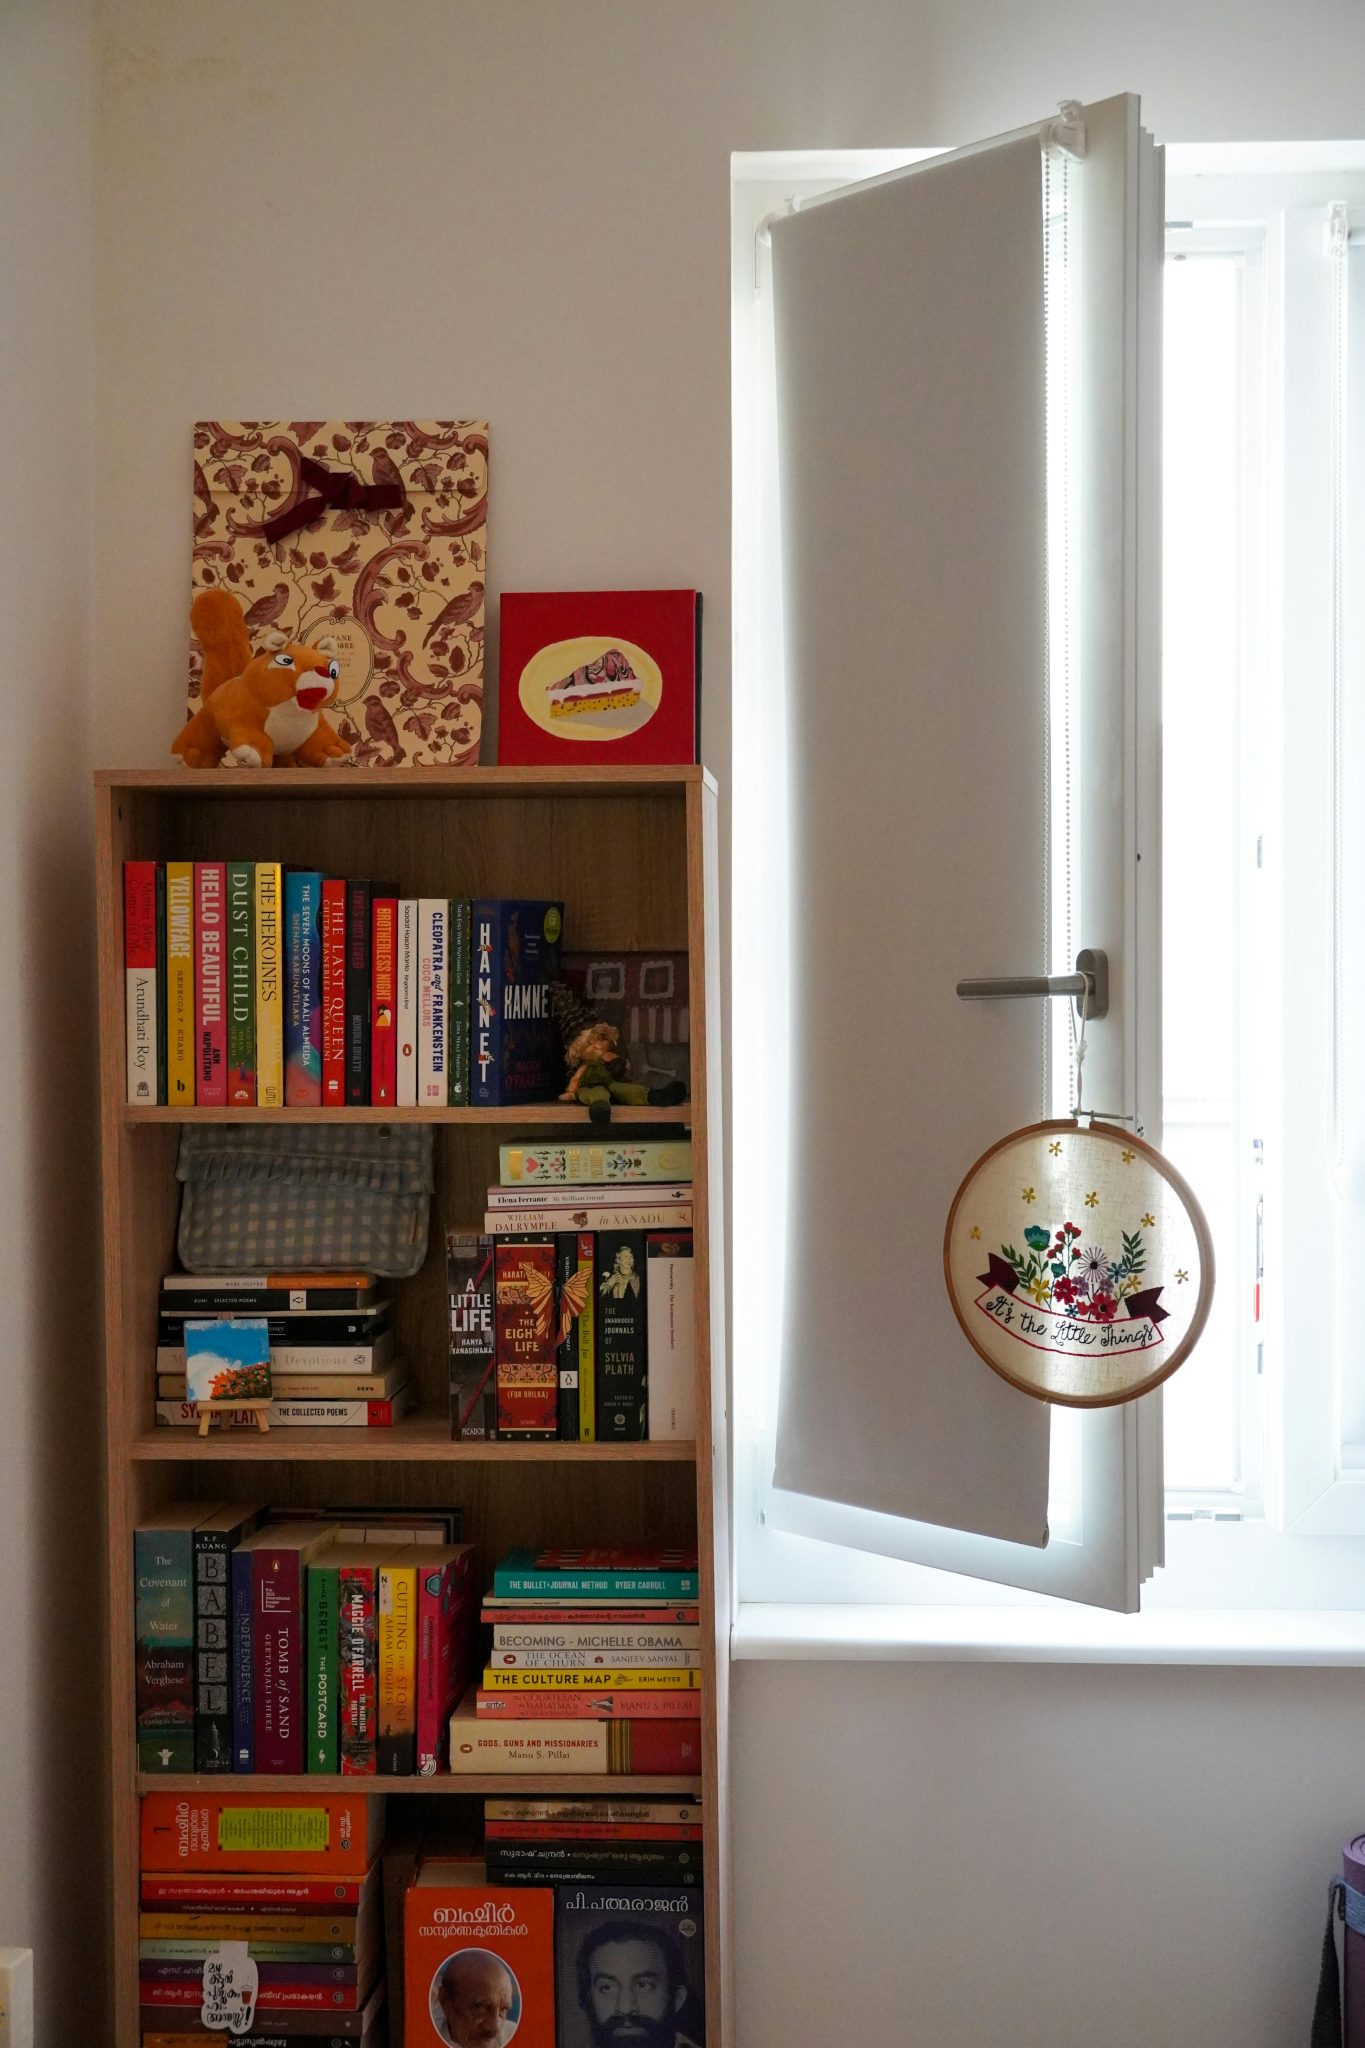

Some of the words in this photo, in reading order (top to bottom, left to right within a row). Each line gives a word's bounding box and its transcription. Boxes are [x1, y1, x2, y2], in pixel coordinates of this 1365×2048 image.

[201, 868, 220, 924] HELLO
[261, 869, 277, 904] THE
[302, 884, 310, 902] THE
[170, 876, 191, 959] YELLOWFACE
[232, 873, 250, 937] DUST
[332, 899, 344, 935] THE
[403, 905, 411, 928] Saadat
[302, 906, 311, 935] SEVEN
[323, 899, 331, 939] CHITRA
[292, 913, 301, 952] SHEHAN
[375, 907, 391, 973] BROTHERLESS
[403, 929, 411, 949] Hasan
[433, 912, 444, 972] CLEOPATRA
[261, 910, 278, 1002] HEROINES
[302, 938, 311, 974] MOONS
[323, 943, 331, 992] BANERJEE
[332, 945, 344, 990] LAST
[403, 950, 411, 973] Manto
[202, 930, 221, 1026] BEAUTIFUL
[422, 958, 431, 981] COCO
[176, 970, 184, 1014] REBECCA
[232, 946, 249, 1022] CHILD
[292, 955, 300, 1027] KARUNATILAKA
[302, 977, 310, 989] OF
[375, 975, 391, 1002] NIGHT
[430, 974, 444, 993] and
[136, 977, 150, 1041] Arundhati
[302, 993, 310, 1022] MAALI
[422, 985, 431, 1027] MELLORS
[478, 922, 492, 1083] HAMNET
[504, 984, 556, 1020] HAMNE
[323, 996, 331, 1062] DIVAKARUNI
[329, 997, 344, 1061] QUEEN
[433, 994, 444, 1073] FRANKENSTEIN
[176, 1030, 184, 1062] KUANG
[203, 1031, 213, 1081] NAPOLITANO
[211, 1047, 221, 1063] ANN
[302, 1025, 311, 1066] ALMEIDA
[133, 1046, 149, 1071] Roy
[497, 1196, 517, 1204] Elena
[518, 1195, 548, 1203] Ferrante
[495, 1222, 558, 1233] DALRYMPLE
[507, 1213, 544, 1222] WILLIAM
[599, 1216, 609, 1226] in
[612, 1213, 665, 1225] XANADU
[465, 1278, 477, 1293] A
[450, 1293, 492, 1309] LITTLE
[604, 1307, 617, 1315] THE
[451, 1309, 493, 1332] LIFE
[519, 1318, 536, 1327] THE
[604, 1327, 635, 1335] JOURNALS
[986, 1294, 1015, 1325] It's
[1019, 1312, 1048, 1336] the
[1050, 1320, 1097, 1347] Little
[1099, 1323, 1154, 1348] Things
[451, 1345, 493, 1355] YANAGIHARA
[461, 1338, 484, 1346] HANYA
[515, 1341, 541, 1353] LIFE
[604, 1351, 636, 1363] SYLVIA
[604, 1364, 635, 1376] PLATH
[279, 1407, 290, 1417] THE
[291, 1406, 325, 1417] COLLECTED
[326, 1406, 348, 1417] POEMS
[461, 1427, 486, 1436] PICADOR
[195, 1542, 228, 1550] KUANG
[155, 1556, 173, 1566] The
[139, 1577, 188, 1589] Covenant
[509, 1580, 522, 1590] THE
[581, 1580, 608, 1590] METHOD
[615, 1580, 637, 1590] RYDER
[637, 1580, 667, 1590] CARROLL
[160, 1598, 171, 1608] of
[351, 1594, 365, 1633] MAGGIE
[396, 1580, 409, 1650] CUTTING
[150, 1620, 179, 1632] Water
[204, 1556, 222, 1712] BABEL
[319, 1602, 329, 1651] BEREST
[279, 1628, 290, 1675] TOMB
[499, 1635, 566, 1647] BECOMING
[577, 1635, 634, 1647] MICHELLE
[637, 1635, 683, 1647] OBAMA
[144, 1659, 185, 1670] Abraham
[240, 1612, 252, 1704] INDEPENDENCE
[264, 1633, 272, 1695] GEETANJALI
[319, 1656, 327, 1671] THE
[351, 1637, 366, 1692] O'FARRELL
[525, 1659, 541, 1668] OF
[544, 1658, 586, 1668] CHURN
[526, 1651, 546, 1659] THE
[549, 1650, 586, 1659] OCEAN
[611, 1655, 647, 1663] SANJEEV
[648, 1655, 679, 1663] SANYAL
[144, 1675, 185, 1687] Verghese
[275, 1679, 290, 1693] of
[384, 1653, 394, 1707] VERGHESE
[493, 1675, 518, 1685] THE
[522, 1674, 579, 1685] CULTURE
[583, 1674, 611, 1684] MAP
[638, 1675, 654, 1683] ERIN
[656, 1675, 681, 1683] MEYER
[278, 1696, 290, 1739] SAND
[317, 1673, 328, 1738] POSTCARD
[350, 1700, 358, 1726] PORTRAIT
[620, 1702, 650, 1711] MANU
[661, 1702, 693, 1711] PILLAI
[358, 1705, 367, 1733] MARRIAGE
[477, 1739, 501, 1748] GODS,
[503, 1739, 524, 1748] GUNS
[526, 1739, 542, 1748] AND
[544, 1739, 600, 1748] MISSIONARIES
[508, 1751, 534, 1760] Manu
[537, 1751, 545, 1759] S.
[547, 1750, 571, 1760] Pillai
[175, 1802, 190, 1857] ബഷീർ
[432, 1901, 516, 1924] ബഷീർ
